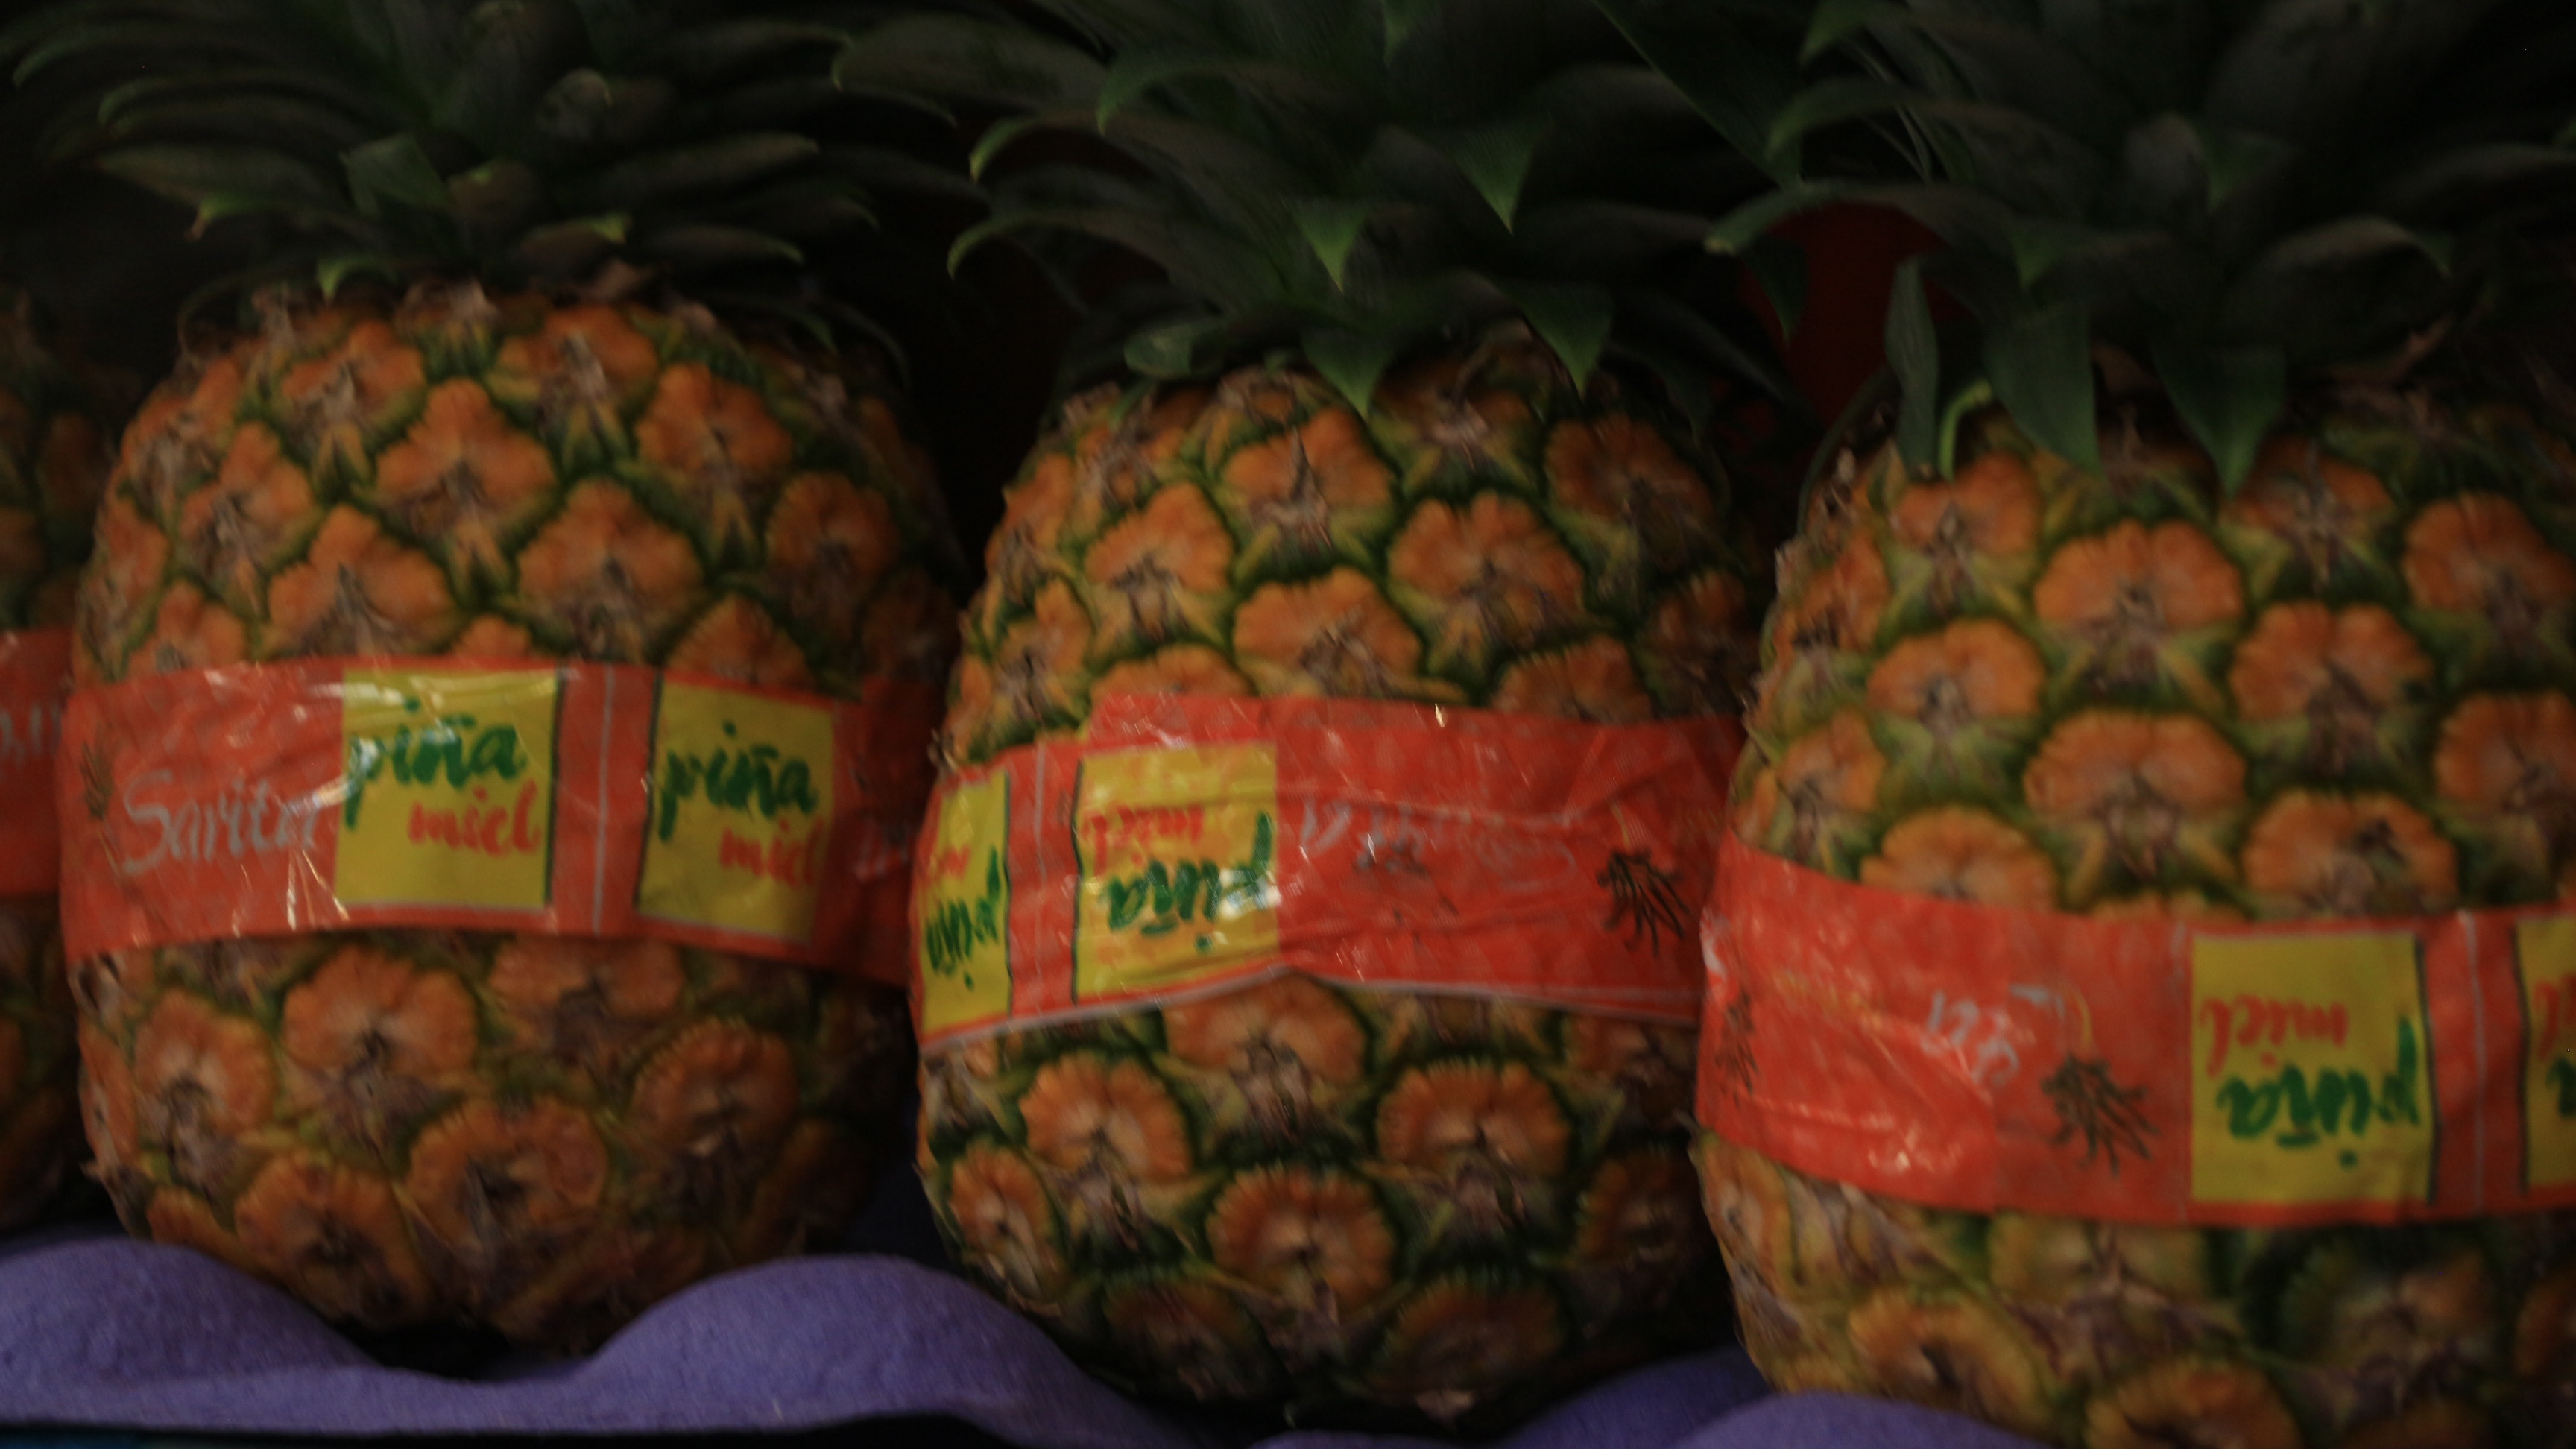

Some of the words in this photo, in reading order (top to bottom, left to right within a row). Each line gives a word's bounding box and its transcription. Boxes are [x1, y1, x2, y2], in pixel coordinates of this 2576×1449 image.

[344, 699, 528, 832] piña
[407, 779, 543, 858] miel
[659, 719, 817, 842] piña
[1099, 810, 1277, 956] piña
[2200, 993, 2349, 1079] miel
[2215, 1014, 2421, 1169] piña
